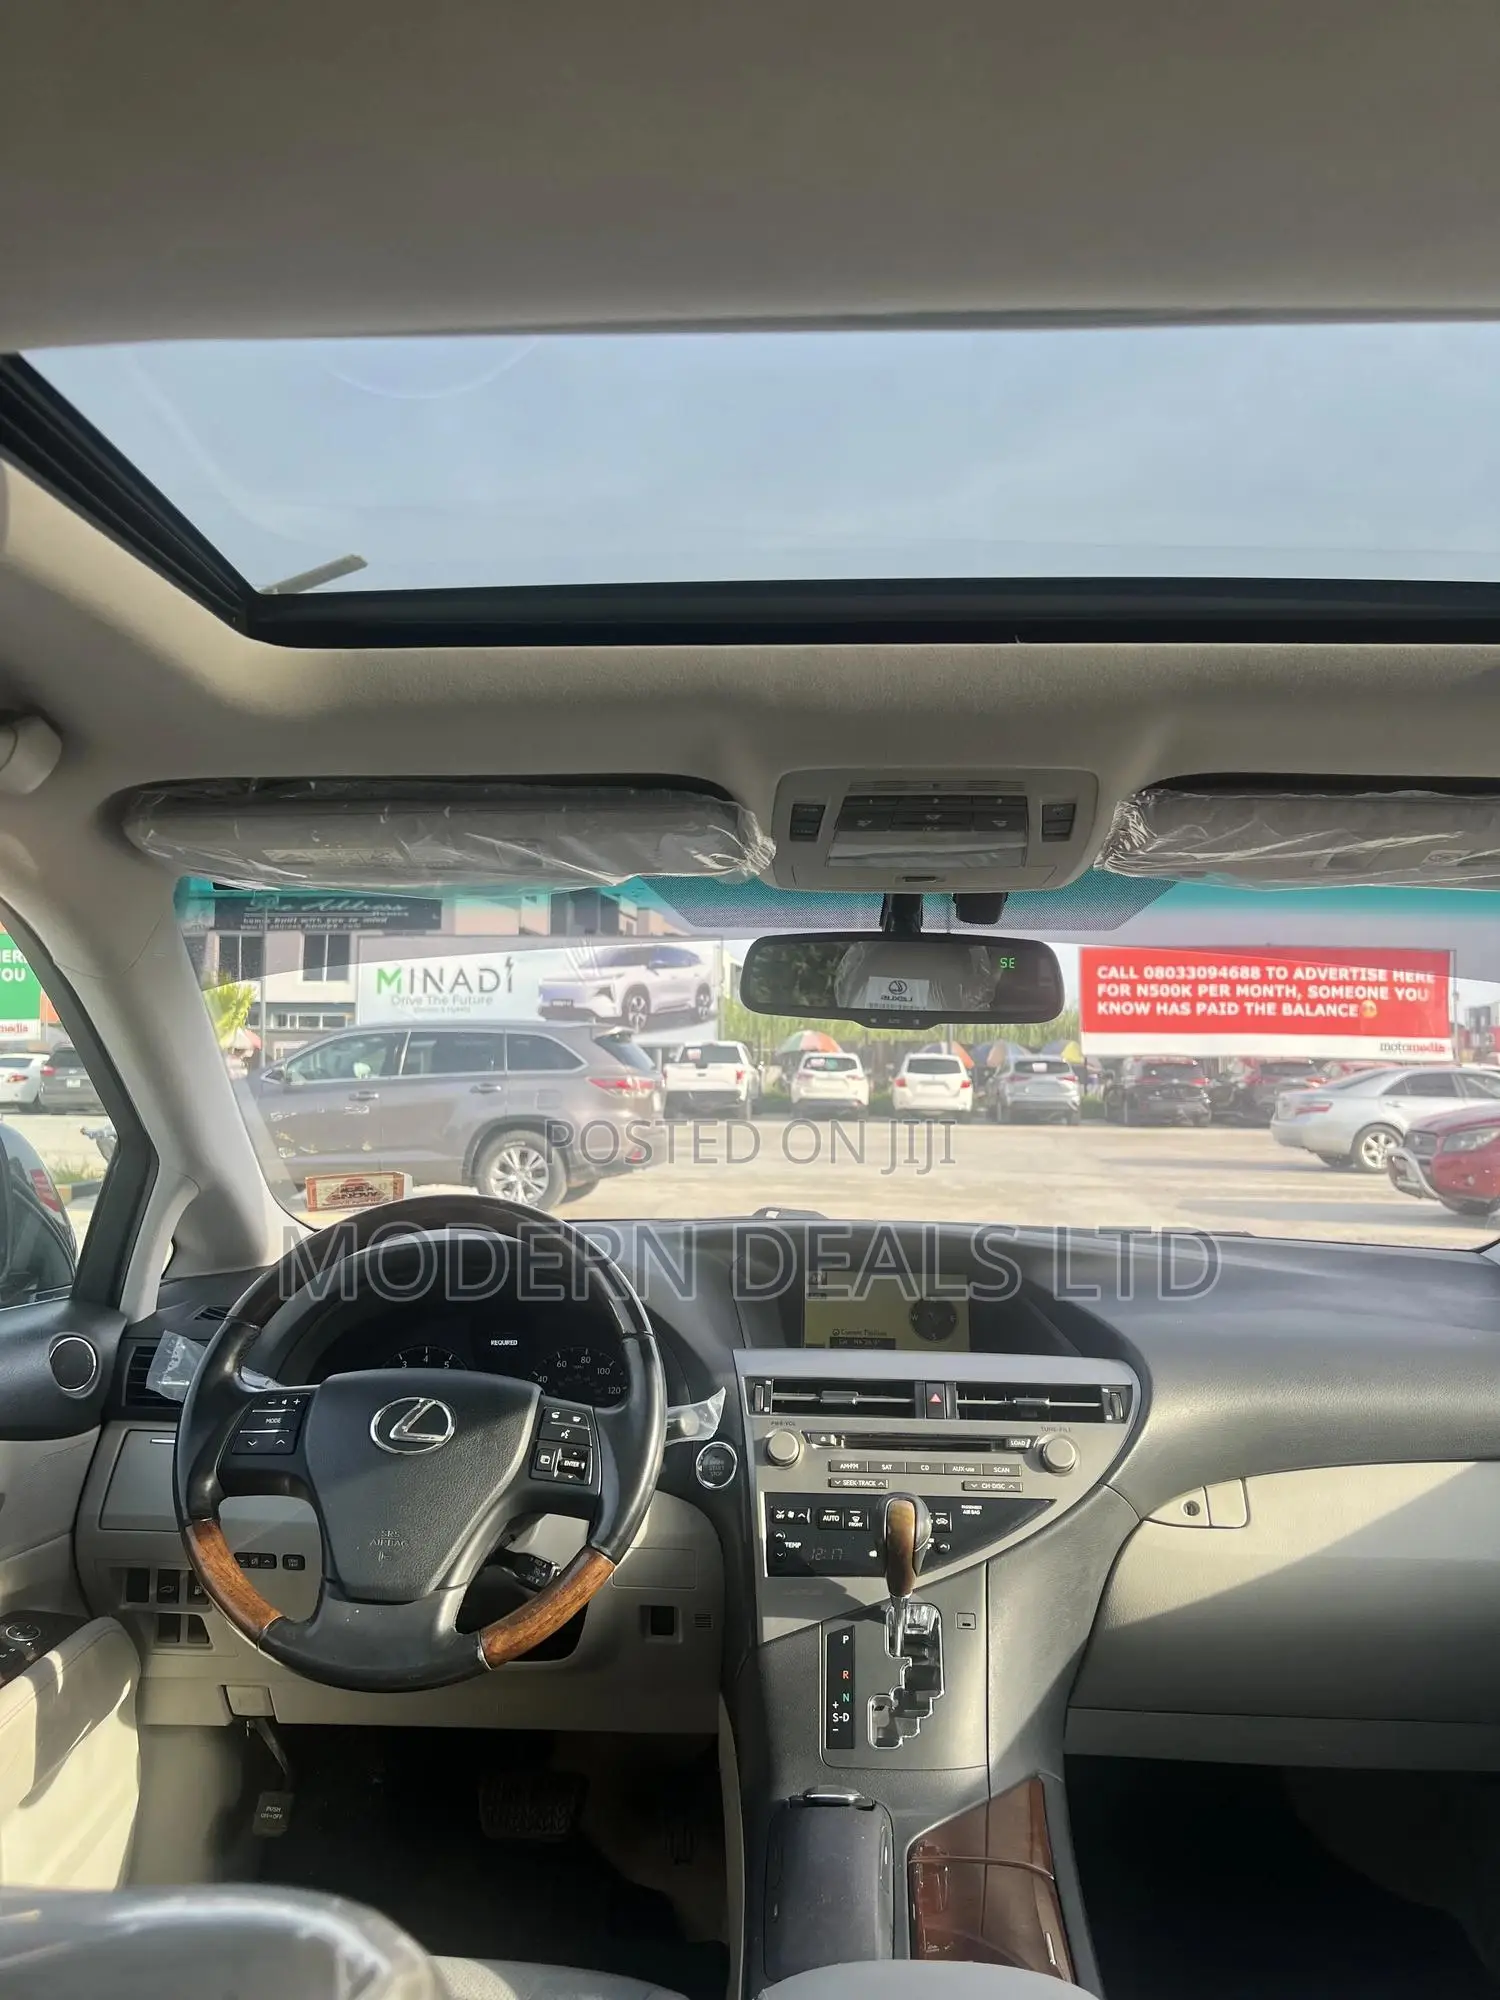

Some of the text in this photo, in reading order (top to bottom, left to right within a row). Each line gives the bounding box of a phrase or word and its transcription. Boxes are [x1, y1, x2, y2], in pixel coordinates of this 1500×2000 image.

[999, 957, 1016, 969] SE
[1097, 965, 1435, 985] CALL 08033094688 TO ADVERTISE HERE
[1097, 983, 1429, 1001] FOR N500K PER MONTH, SOMEONE YOU
[391, 994, 494, 1006] Drive The Future
[1097, 1001, 1359, 1017] KNOW HAS PAID THE BALANCE
[423, 1354, 429, 1363] 4
[580, 1355, 592, 1364] 80
[401, 1360, 408, 1369] 3
[444, 1360, 450, 1369] 5
[556, 1359, 568, 1369] 60
[596, 1366, 611, 1376] 100
[537, 1374, 548, 1384] 40
[607, 1385, 621, 1395] 120
[564, 1460, 580, 1468] ENTER
[822, 1514, 840, 1523] AUTO
[784, 1541, 802, 1549] TEMP
[842, 1635, 850, 1644] P
[842, 1670, 849, 1679] R
[842, 1693, 850, 1702] N
